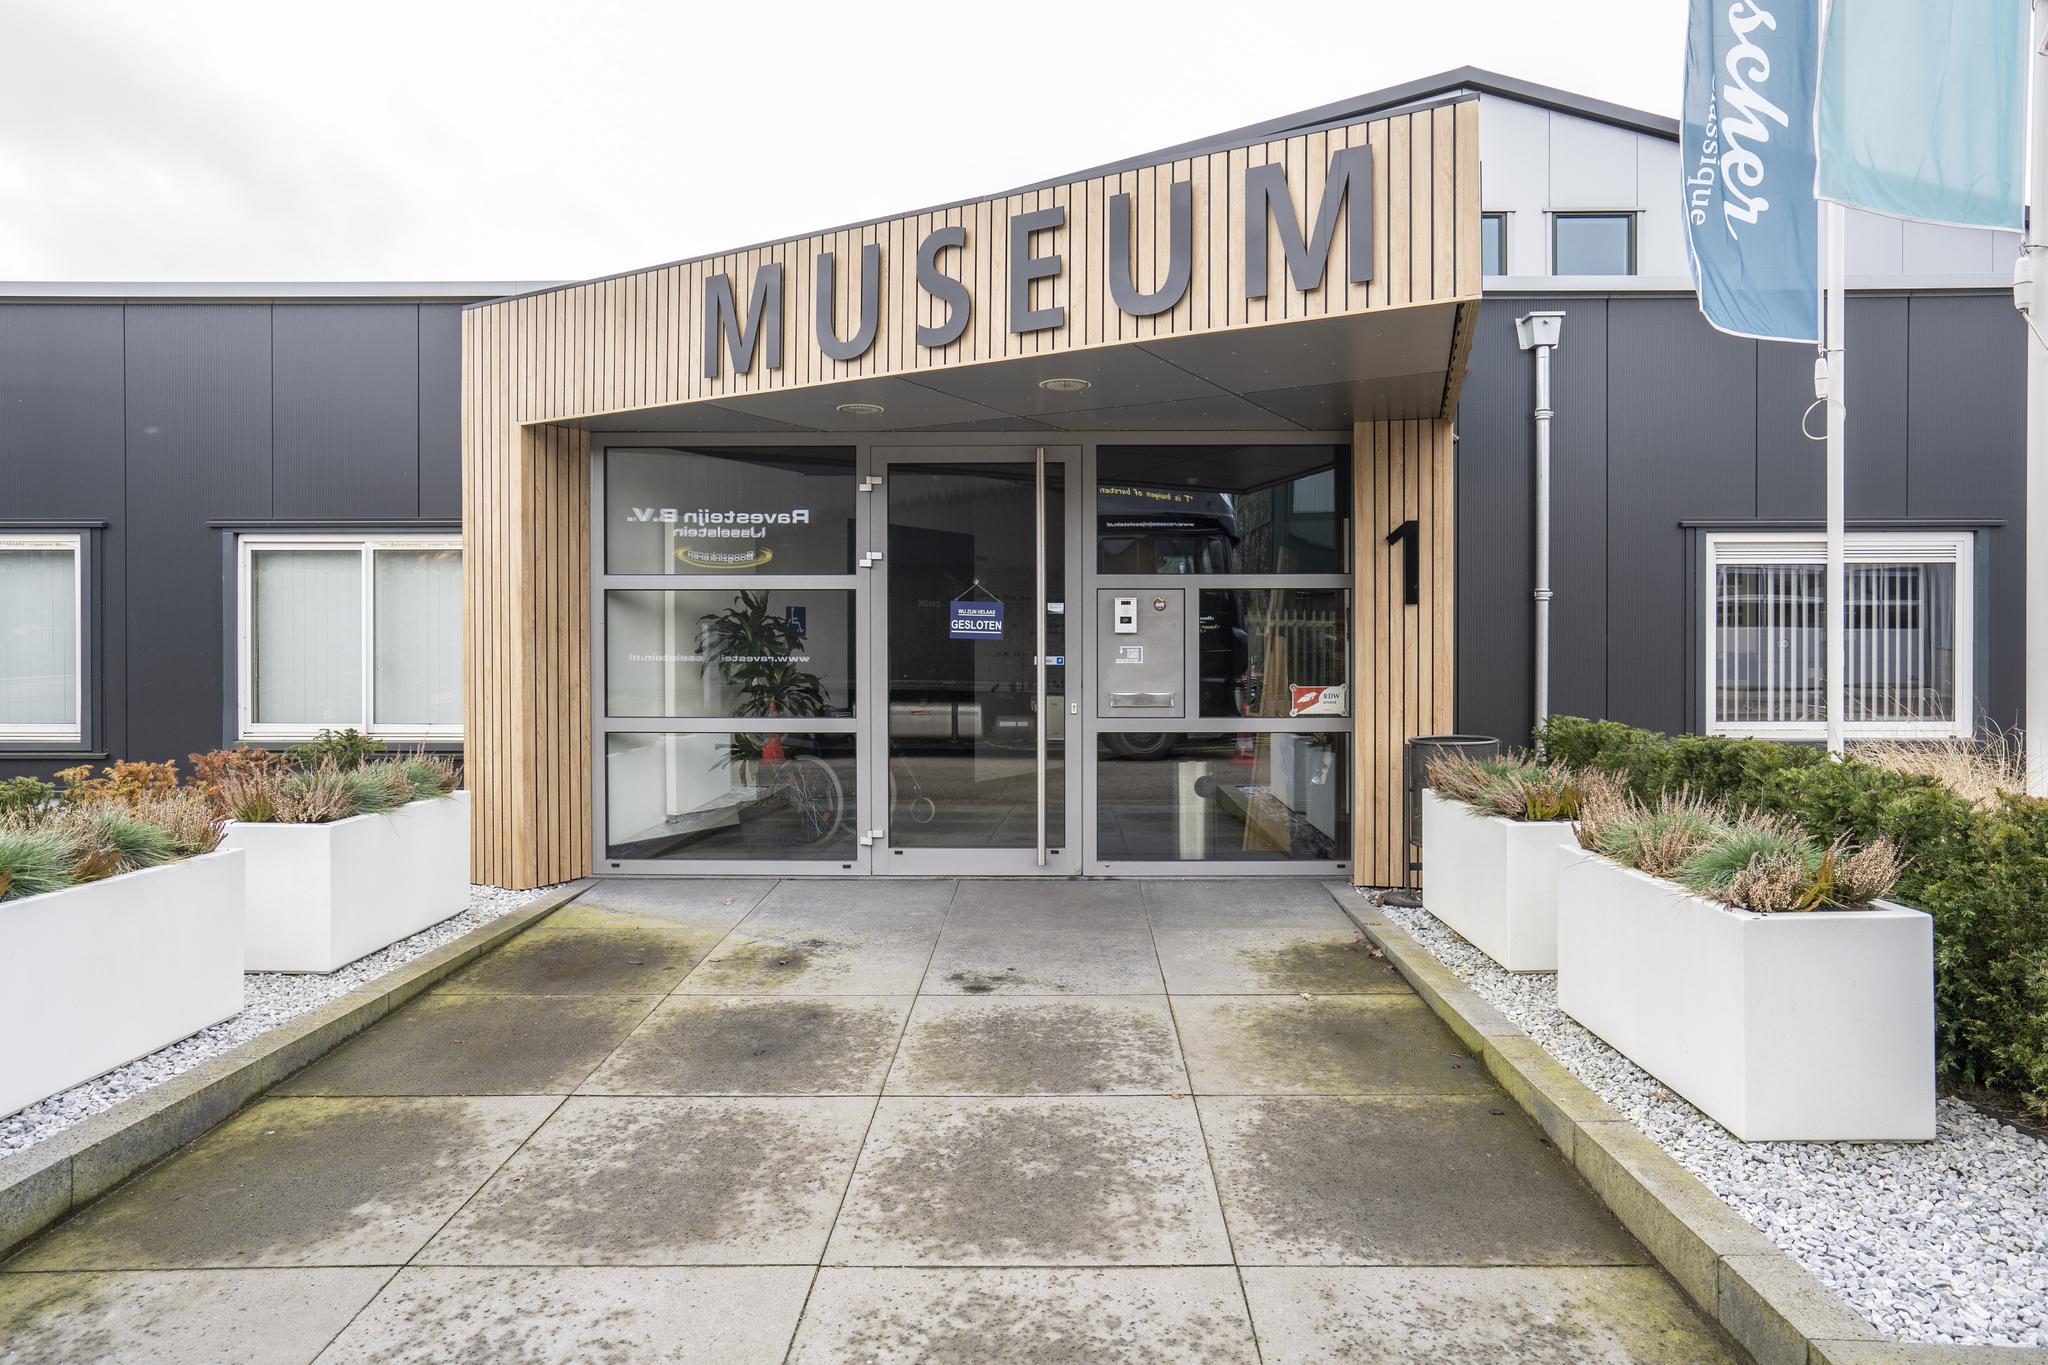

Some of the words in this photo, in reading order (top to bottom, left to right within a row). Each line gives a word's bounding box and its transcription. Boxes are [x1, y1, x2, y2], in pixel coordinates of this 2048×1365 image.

[1687, 74, 1721, 226] assique
[703, 143, 1373, 379] MUSEUM
[1385, 520, 1419, 604] 1
[951, 619, 1002, 630] GESLOTEN
